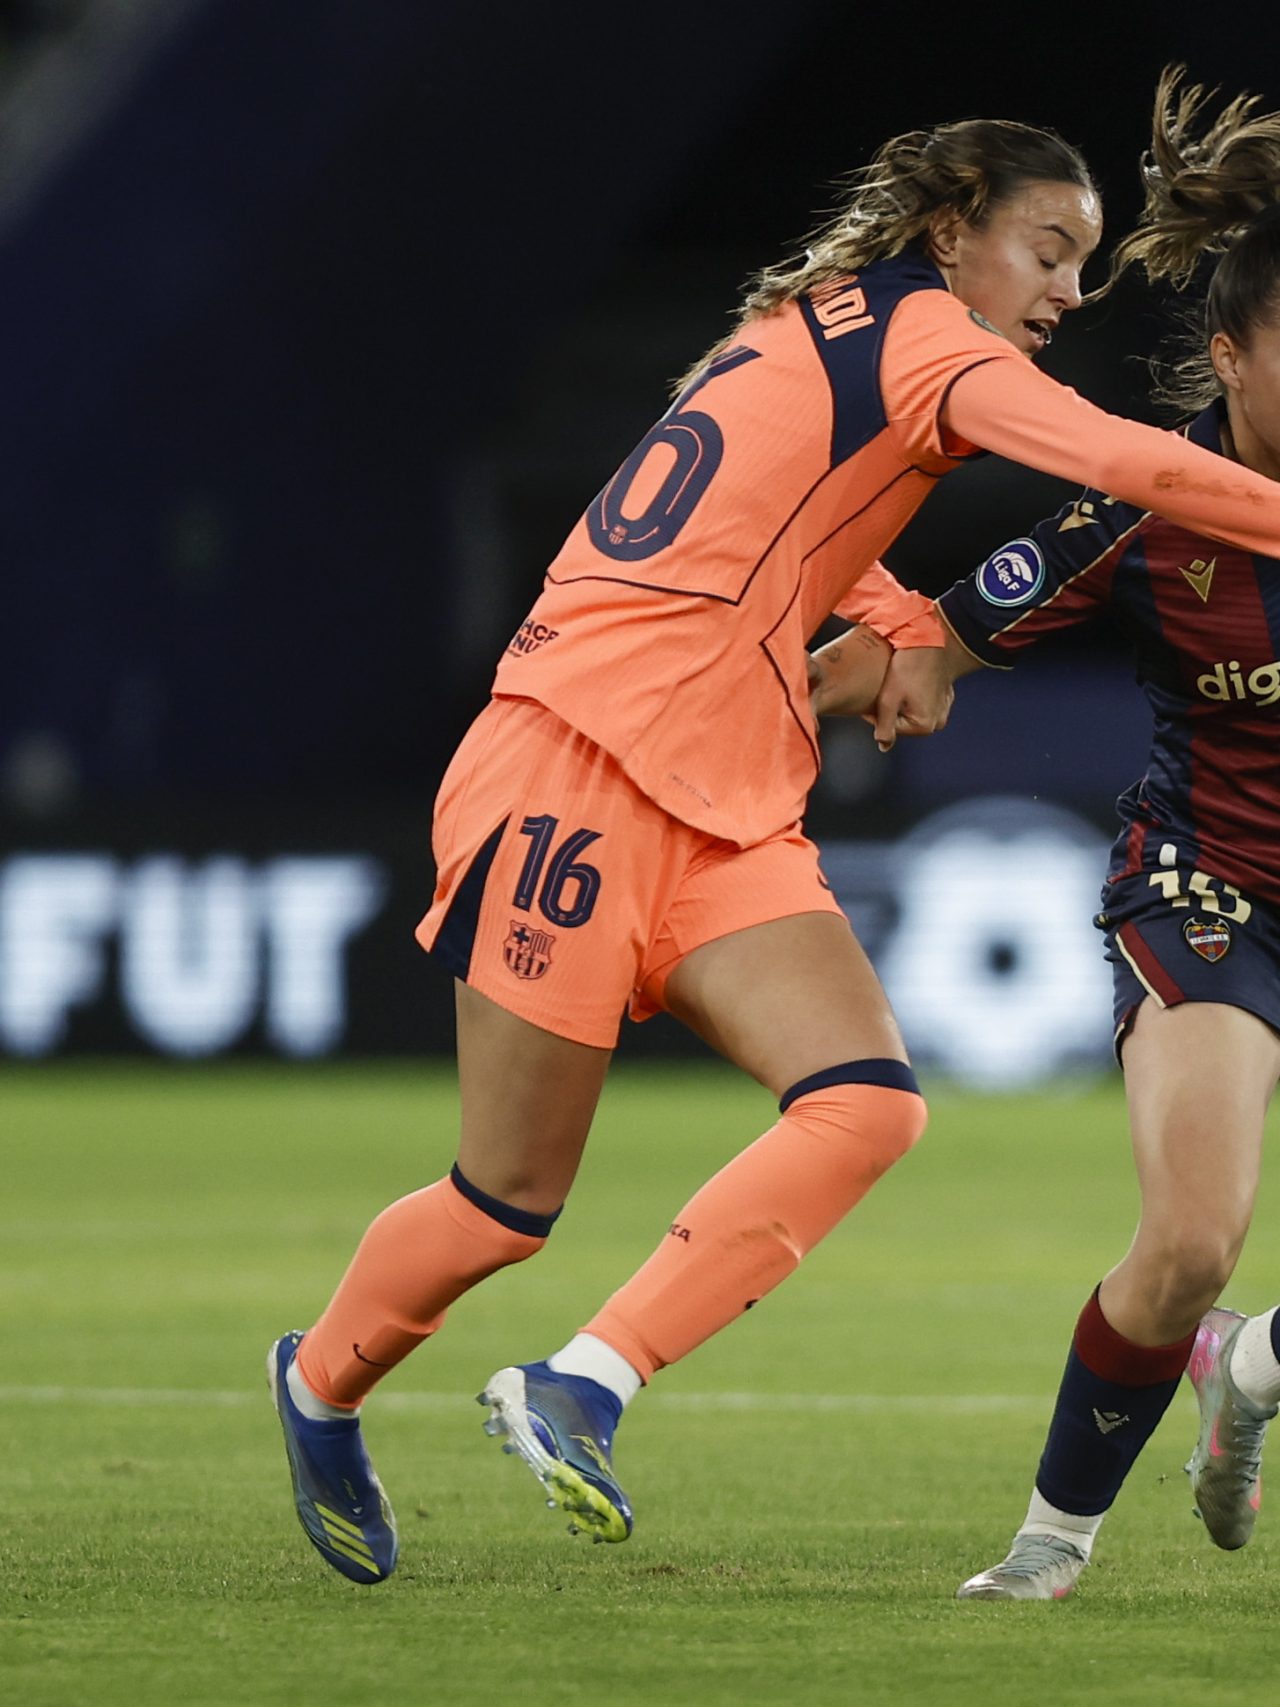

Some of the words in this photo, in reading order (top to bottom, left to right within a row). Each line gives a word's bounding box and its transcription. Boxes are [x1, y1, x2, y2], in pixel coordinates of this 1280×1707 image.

[1006, 581, 1021, 592] F
[510, 813, 604, 929] 16
[0, 855, 382, 1058] FUT
